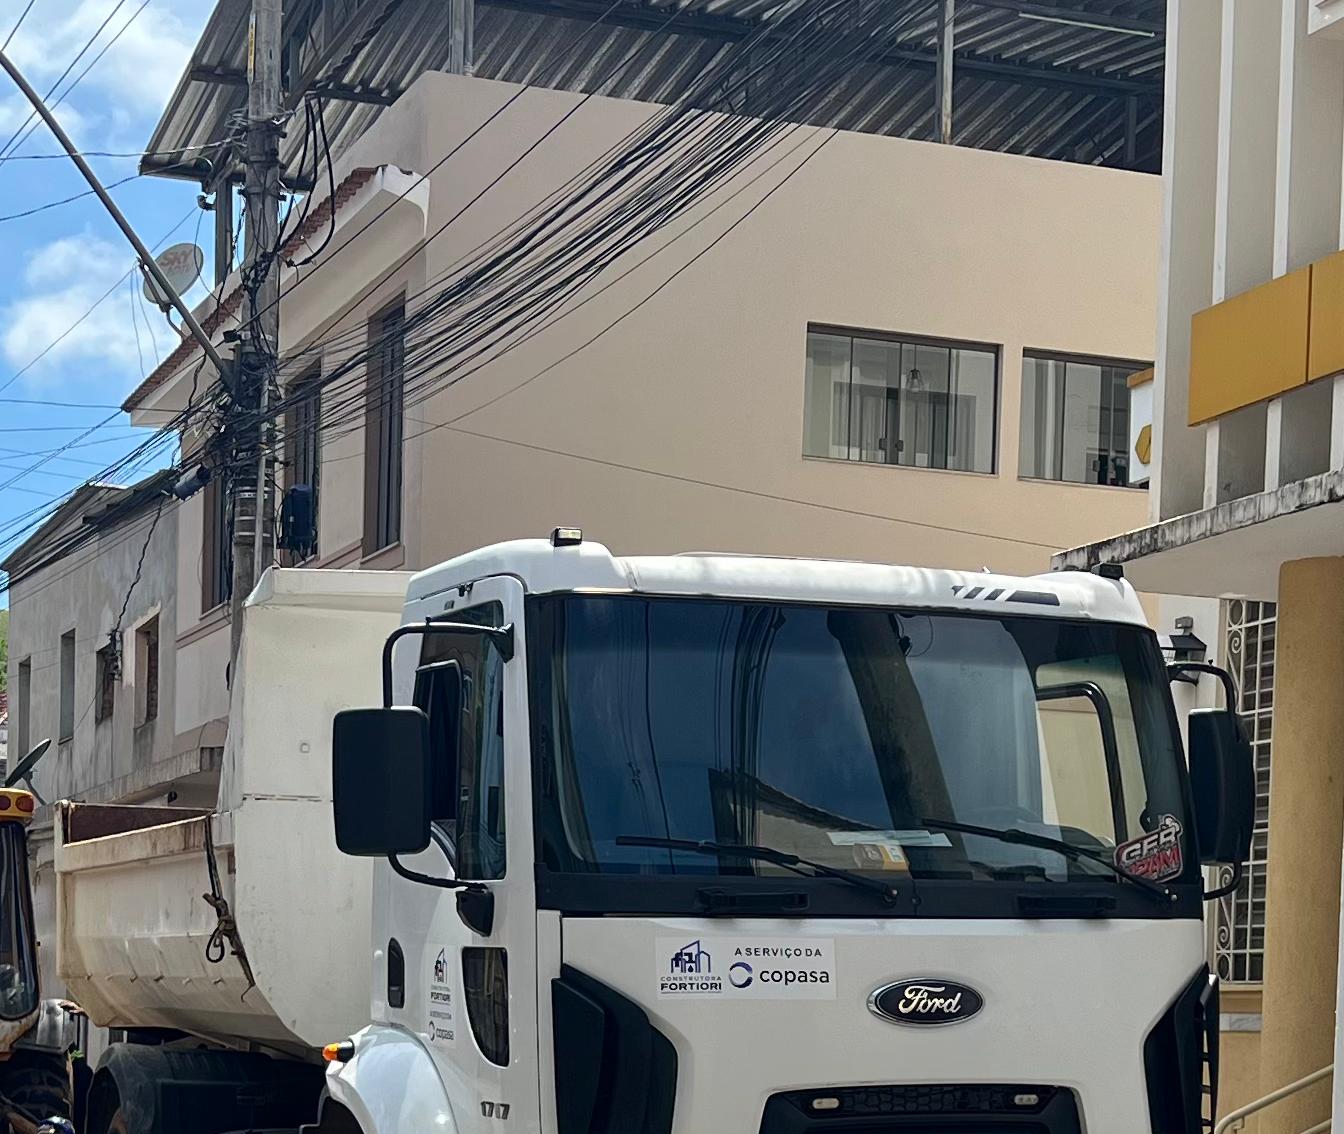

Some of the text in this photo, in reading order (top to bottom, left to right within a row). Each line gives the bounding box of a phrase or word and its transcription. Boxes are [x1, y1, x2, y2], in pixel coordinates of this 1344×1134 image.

[759, 970, 830, 986] copasa
[660, 983, 722, 991] FORTIORI
[898, 985, 962, 1013] Ford
